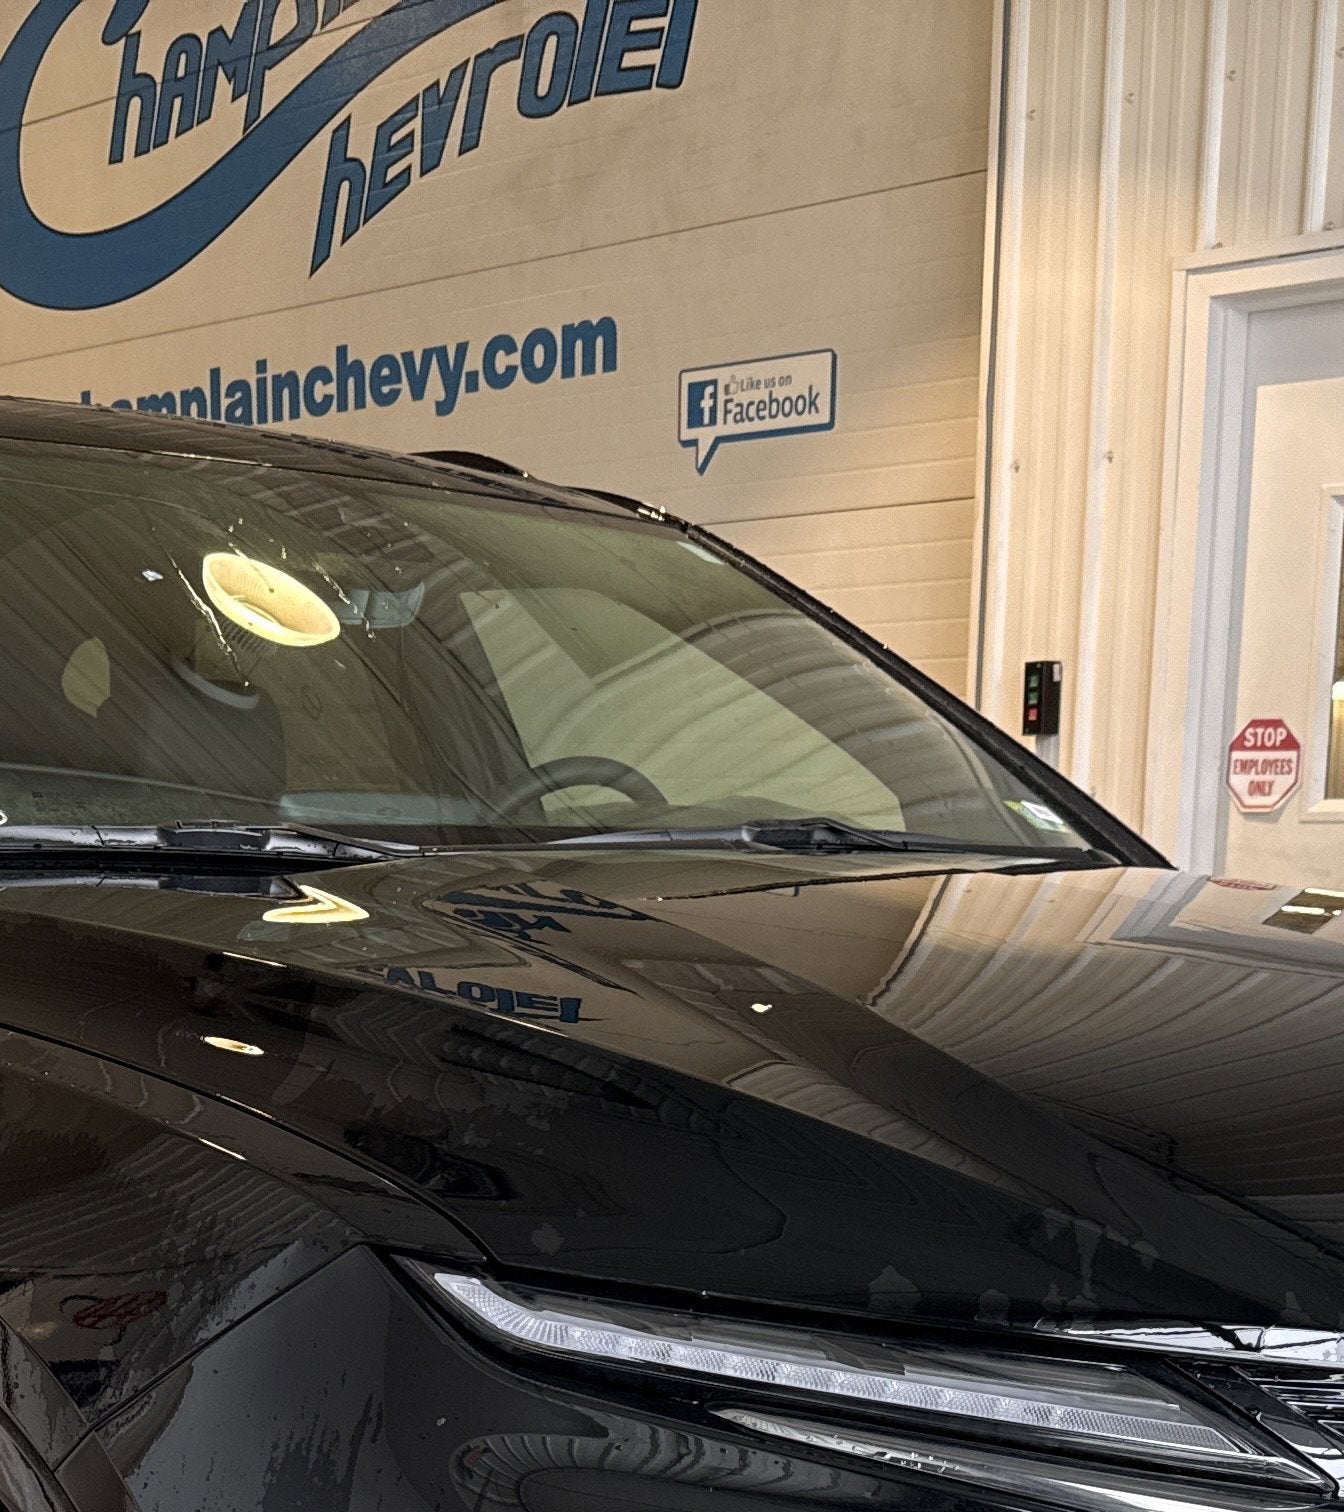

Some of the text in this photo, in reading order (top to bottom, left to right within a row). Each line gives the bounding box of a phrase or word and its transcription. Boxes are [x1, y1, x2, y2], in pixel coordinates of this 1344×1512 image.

[740, 374, 792, 392] Like us on
[724, 385, 820, 425] Facebook
[1244, 727, 1287, 747] STOP
[1234, 758, 1293, 775] EMPLOYEES
[1247, 780, 1274, 797] ONLY
